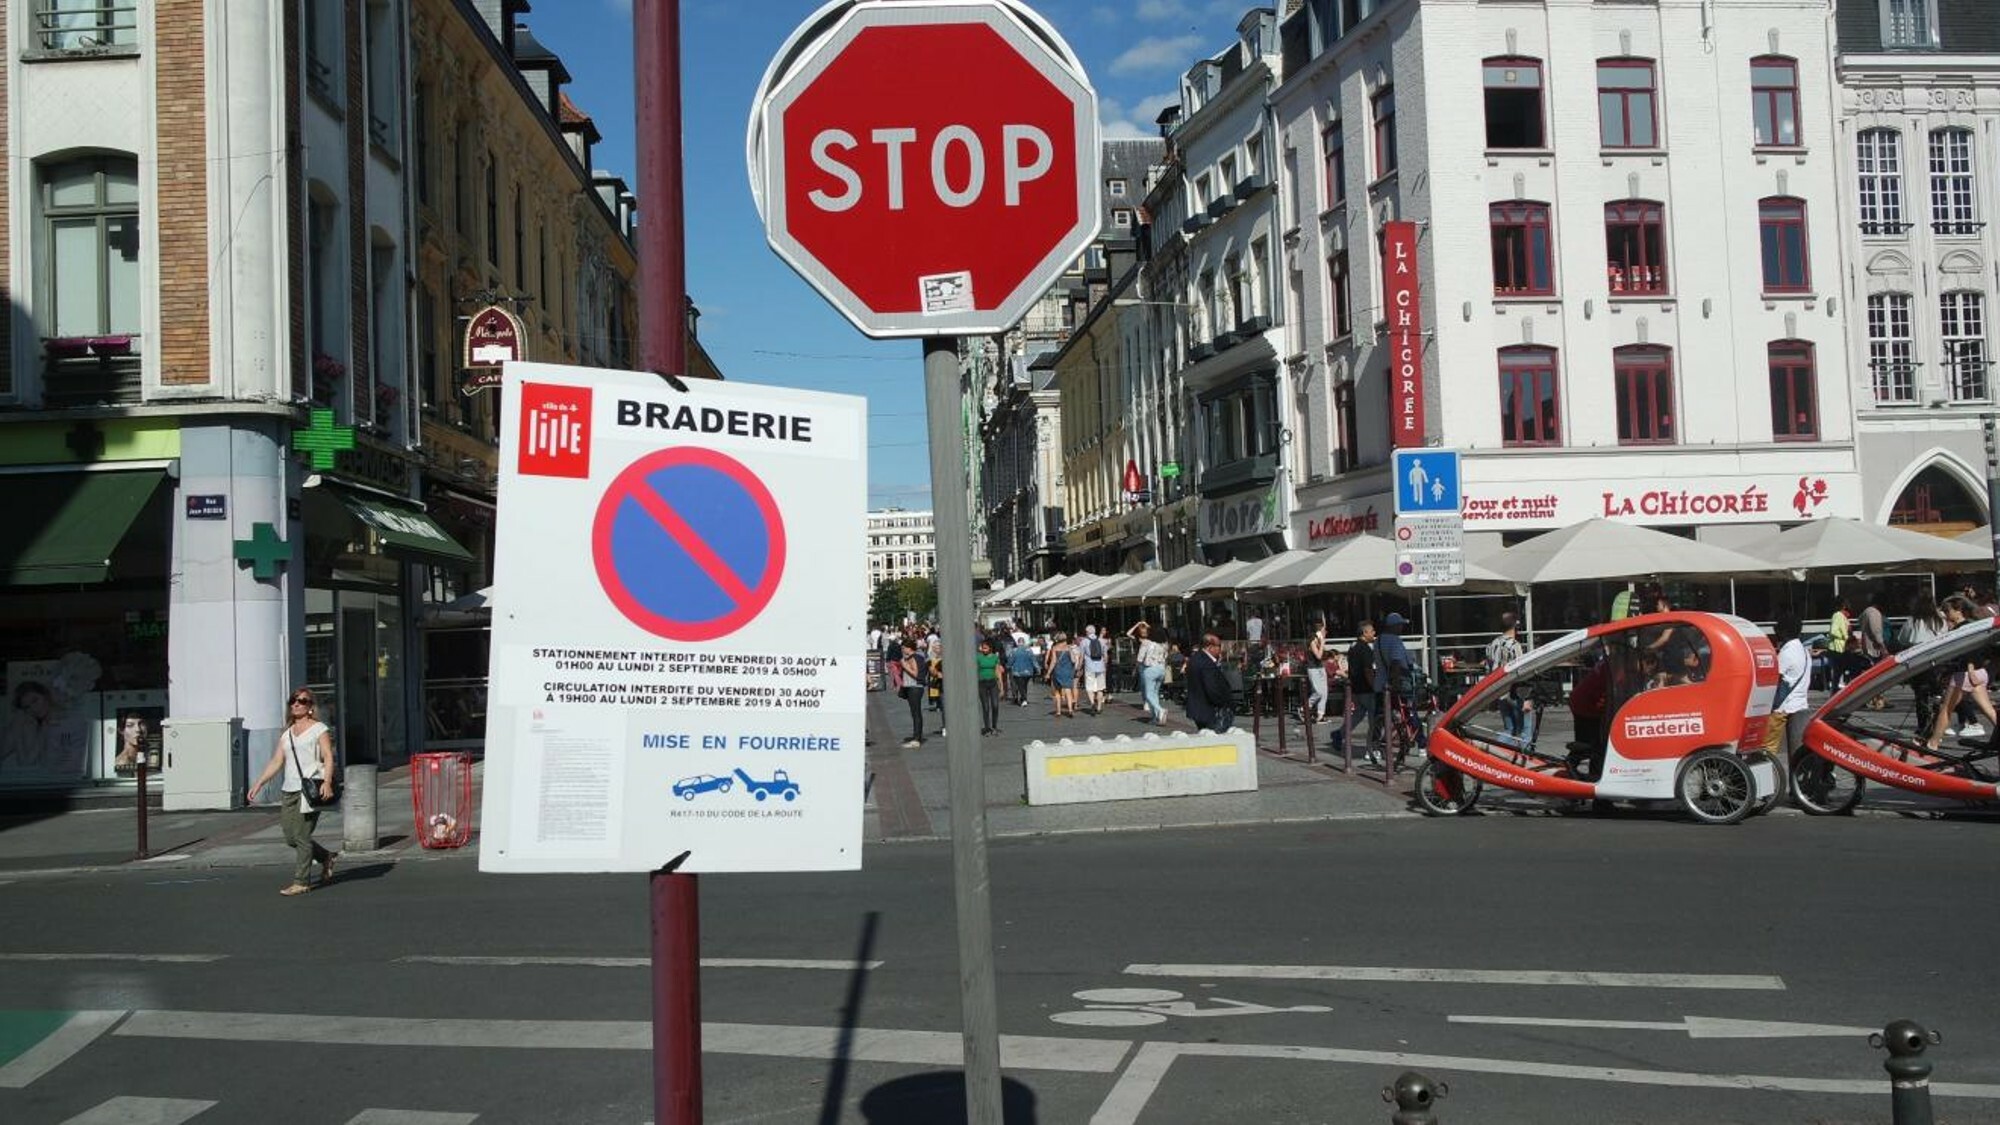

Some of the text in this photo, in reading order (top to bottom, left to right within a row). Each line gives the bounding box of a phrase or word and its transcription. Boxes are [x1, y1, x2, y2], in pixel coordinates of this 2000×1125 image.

[808, 124, 1054, 212] STOP
[617, 399, 812, 443] BRADERIE
[1461, 495, 1558, 511] Jour et nuit
[1461, 509, 1555, 519] service continu
[533, 649, 636, 660] STATIONNEMENT
[640, 652, 695, 662] INTERDIT
[699, 654, 715, 663] DU
[719, 654, 777, 665] VENDREDI
[780, 656, 793, 665] 30
[555, 661, 594, 670] 01H00
[597, 662, 614, 671] AU
[617, 663, 654, 672] LUNDI
[658, 664, 665, 672] 2
[669, 664, 738, 674] SEPTEMBRE
[742, 666, 769, 675] 2019
[782, 667, 817, 676] 05H00
[544, 682, 627, 694] CIRCULATION
[631, 684, 695, 695] INTERDITE
[698, 686, 714, 695] DU
[717, 686, 775, 697] VENDREDI
[779, 688, 792, 697] 30
[560, 694, 596, 703] 19H00
[600, 695, 616, 704] AU
[620, 695, 657, 705] LUNDI
[661, 697, 668, 705] 2
[672, 696, 741, 707] SEPTEMBRE
[745, 698, 771, 707] 2019
[785, 698, 820, 708] 01H00
[1627, 720, 1701, 736] Braderie
[643, 733, 840, 752] MISE EN FOURRIÈRE
[1444, 749, 1535, 786] www.boulanger.com
[1822, 742, 1926, 786] www.boulanger.com
[707, 810, 719, 818] DU
[721, 810, 746, 818] CODE
[748, 810, 759, 818] DE
[762, 810, 773, 818] LA
[775, 810, 803, 818] ROUTE
